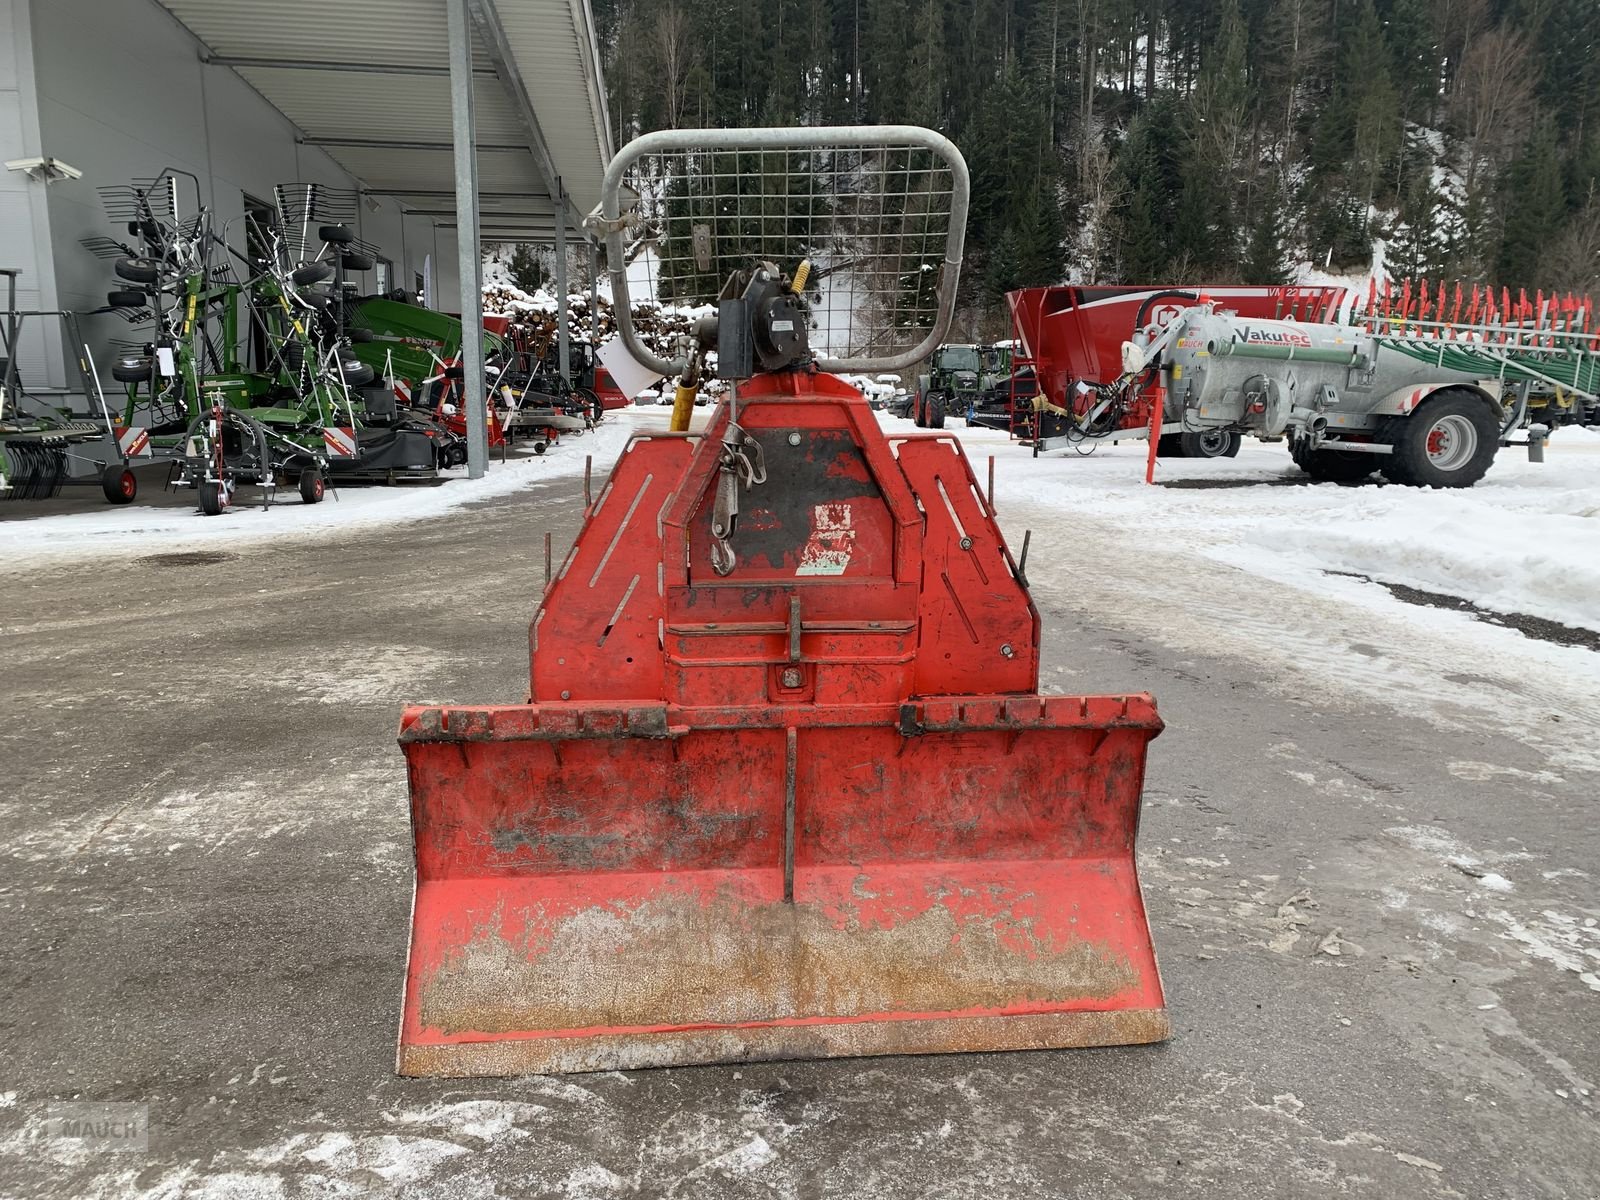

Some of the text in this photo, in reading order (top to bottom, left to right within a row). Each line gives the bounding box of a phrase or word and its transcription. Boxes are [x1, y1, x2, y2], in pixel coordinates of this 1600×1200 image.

[1285, 287, 1299, 297] 22
[1234, 325, 1312, 344] Vakutec
[1177, 337, 1204, 348] MAUCH
